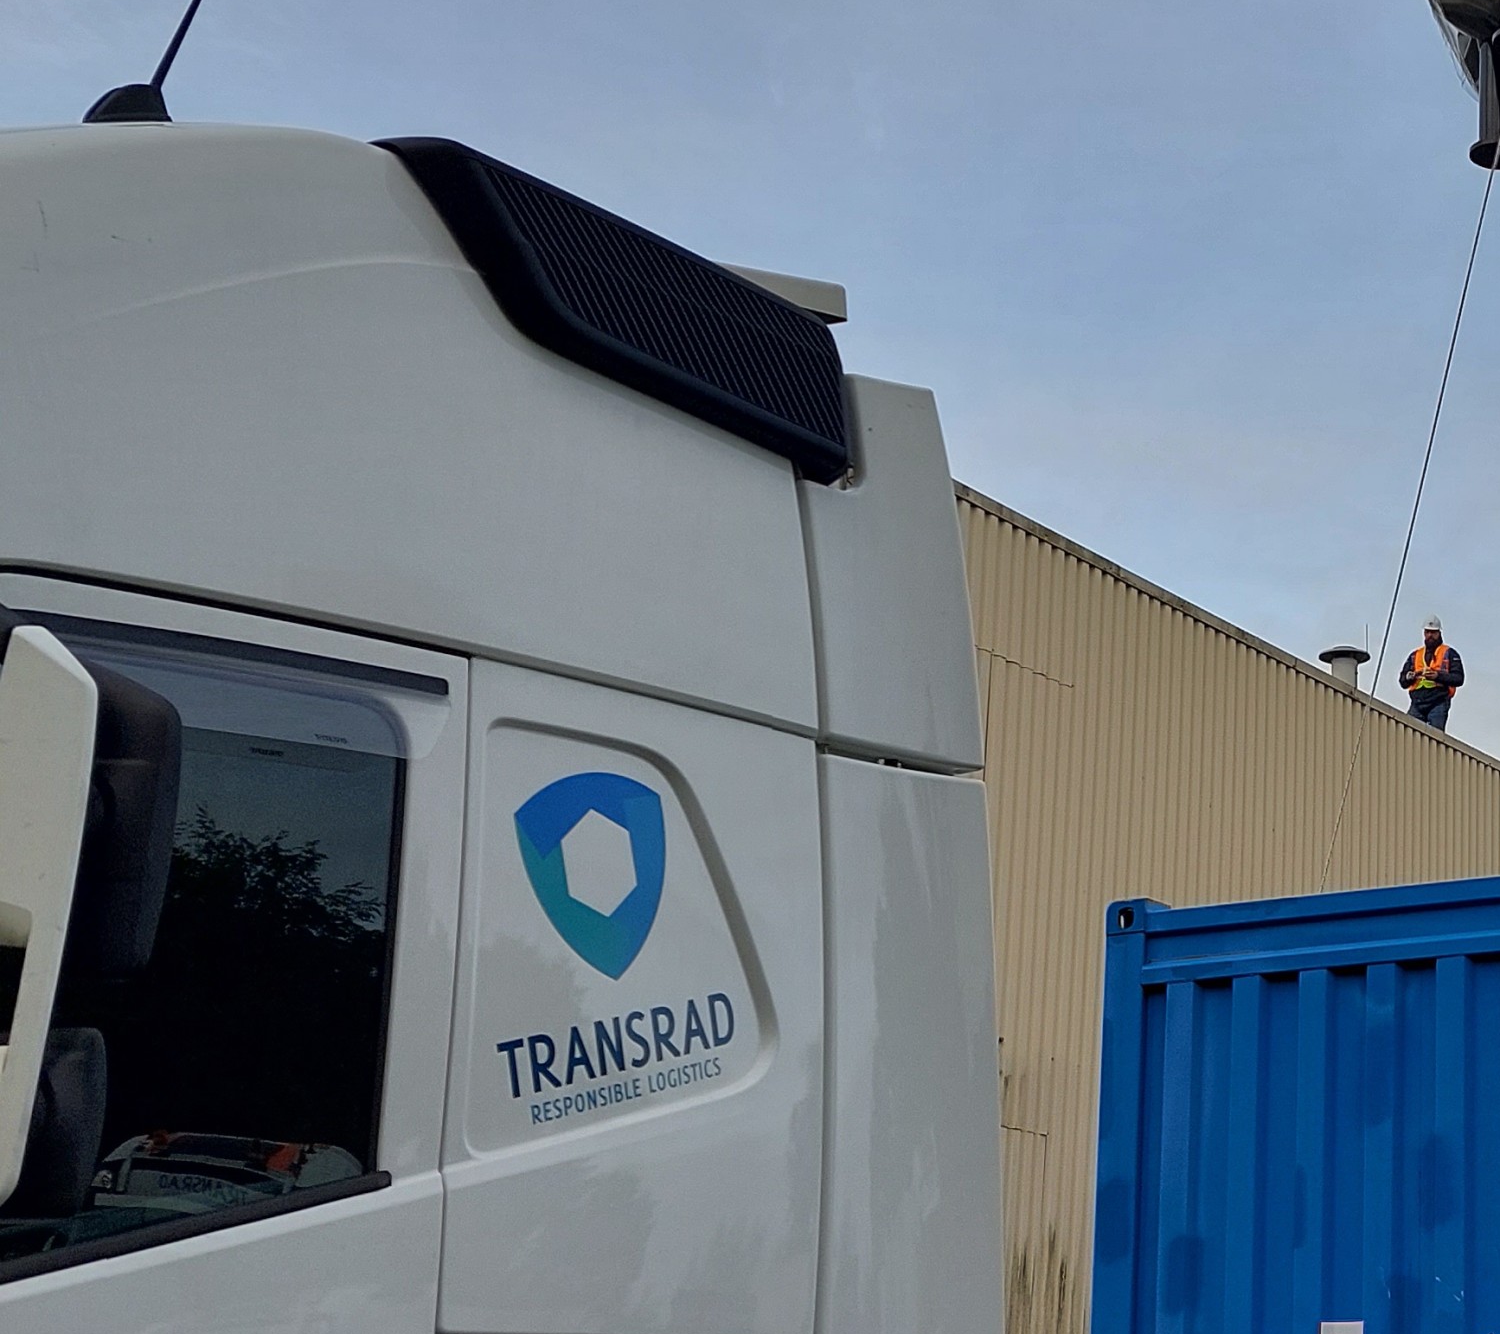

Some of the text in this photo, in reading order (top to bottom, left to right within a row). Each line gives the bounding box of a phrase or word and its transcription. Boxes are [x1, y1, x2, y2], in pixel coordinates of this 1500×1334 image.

[496, 992, 735, 1099] TRANSRAD
[530, 1057, 722, 1125] RESPONSIBLE LOGISTICS
